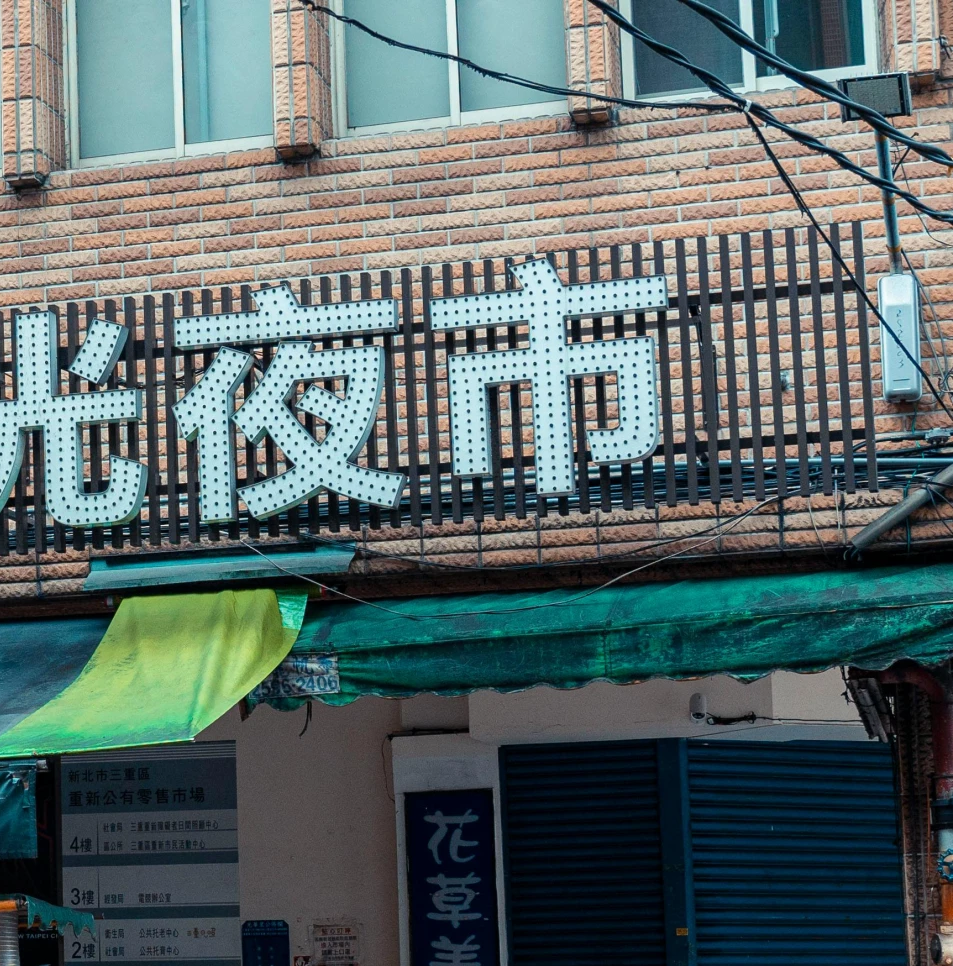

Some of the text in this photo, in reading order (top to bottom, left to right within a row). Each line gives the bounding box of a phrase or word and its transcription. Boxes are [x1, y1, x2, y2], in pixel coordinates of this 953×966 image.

[68, 766, 151, 783] 新北市三重區
[68, 786, 206, 808] 重新公有零售市場
[69, 836, 93, 854] 4樓
[70, 887, 95, 906] 3樓
[71, 941, 96, 959] 2樓
